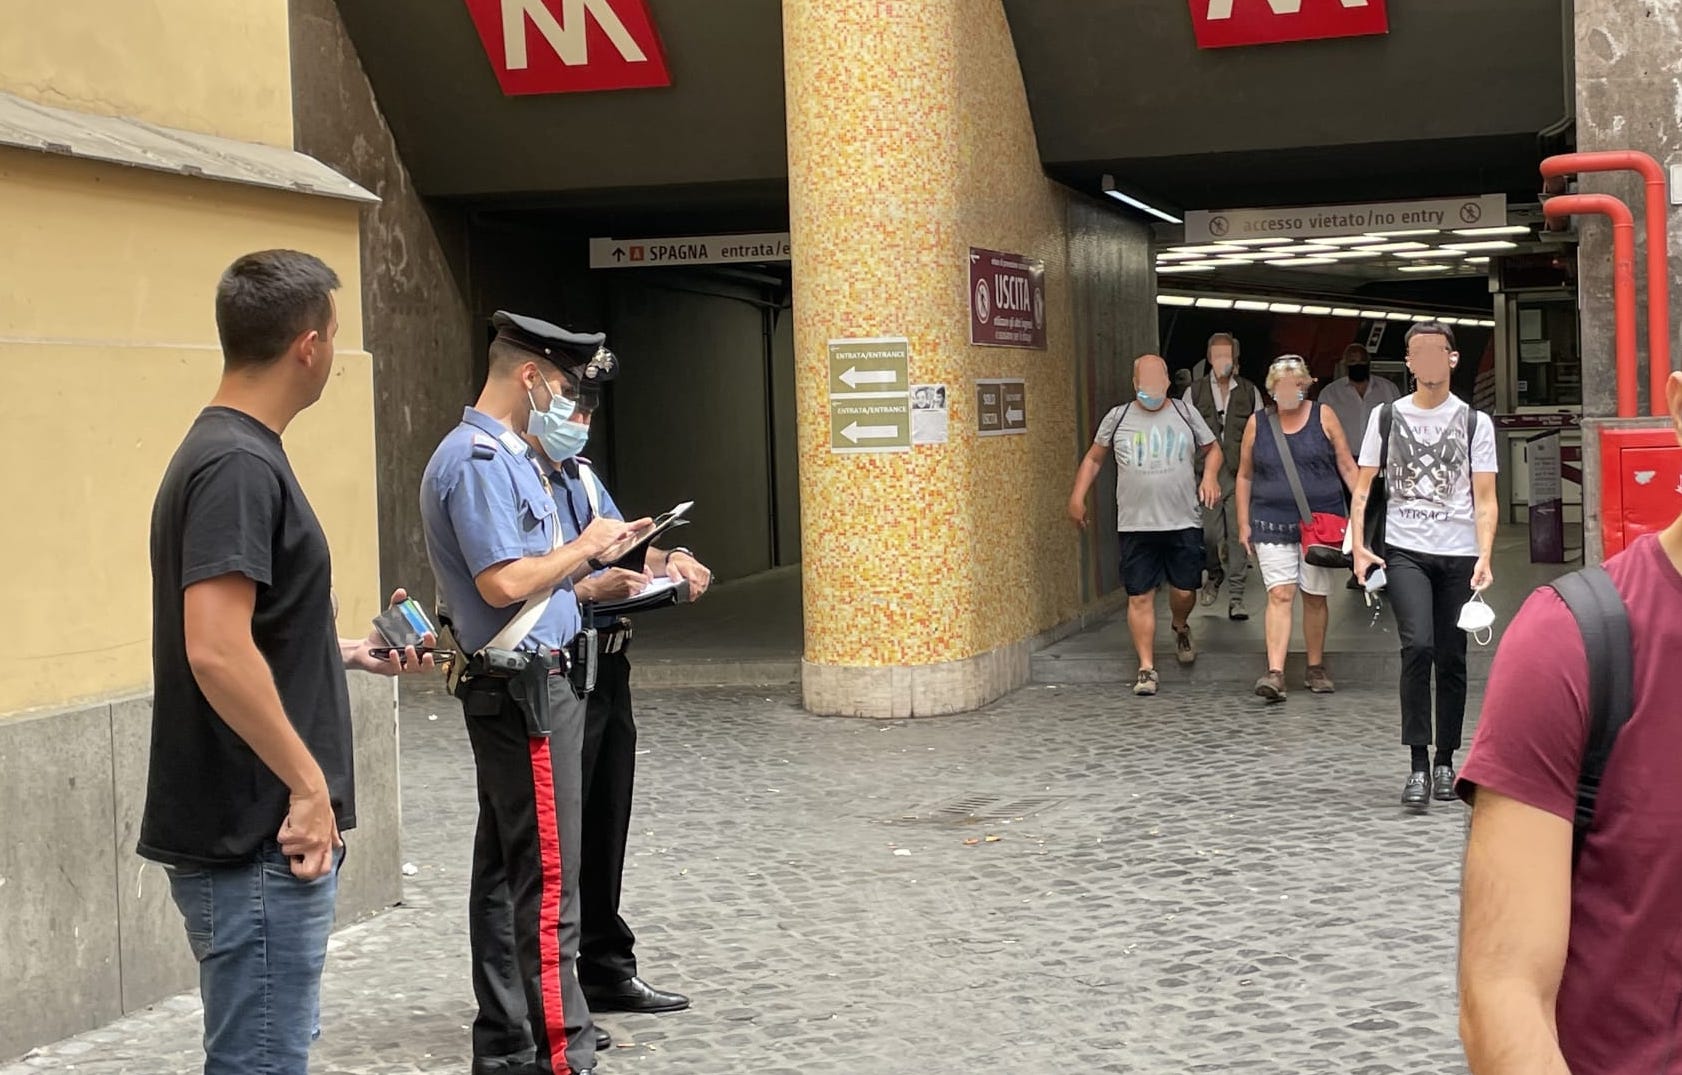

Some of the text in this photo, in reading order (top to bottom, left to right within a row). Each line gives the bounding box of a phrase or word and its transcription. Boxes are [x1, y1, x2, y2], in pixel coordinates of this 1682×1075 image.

[500, 0, 647, 70] M
[1243, 209, 1444, 231] accesso vietato/no entry
[650, 244, 708, 261] SPAGNA
[721, 241, 790, 258] entrata/e
[994, 274, 1031, 312] USCITA
[836, 351, 905, 360] ENTRATA/ENTRANCE
[837, 406, 907, 415] ENTRATA/ENTRANCE
